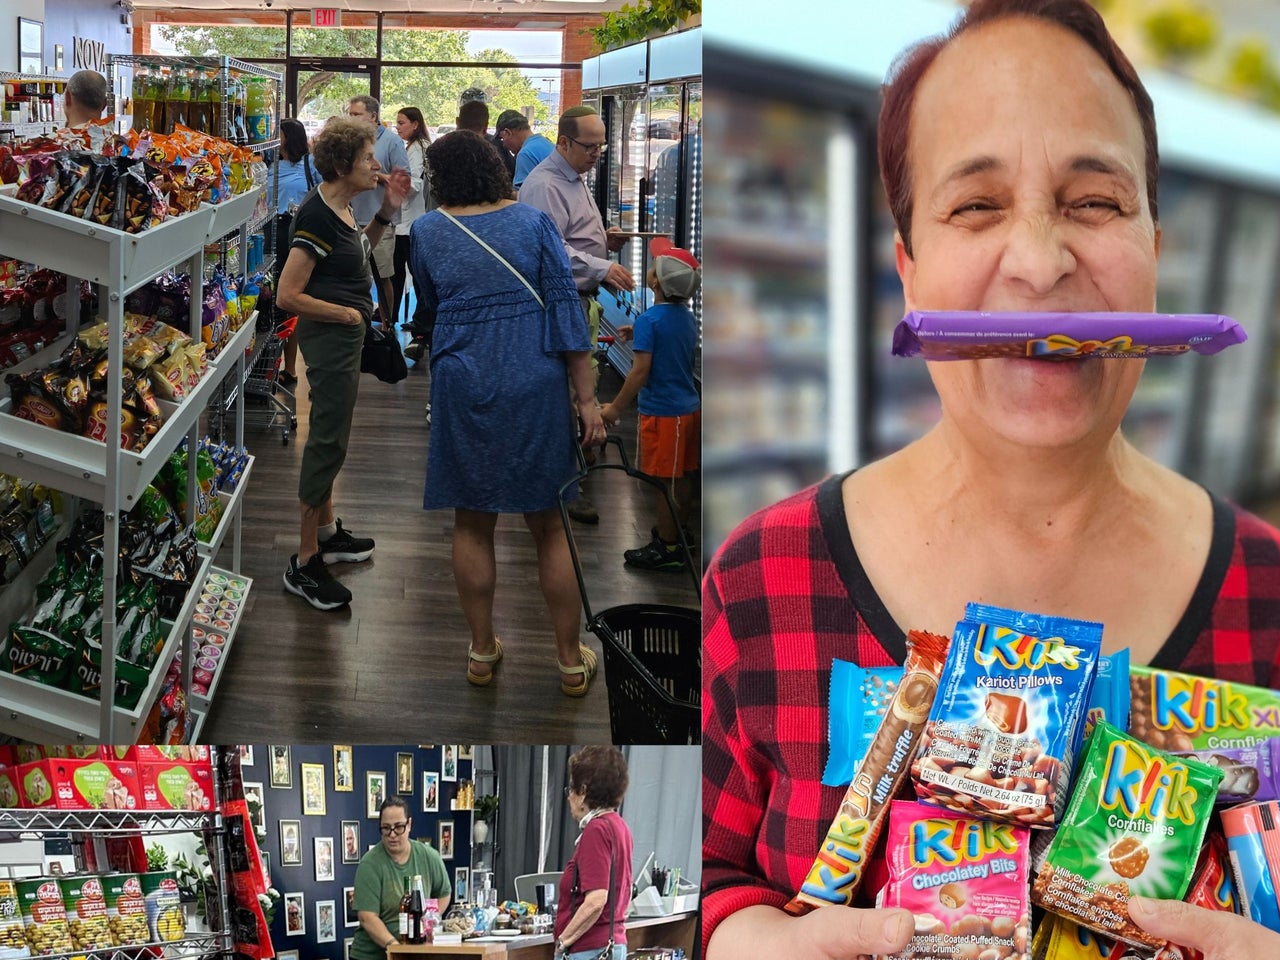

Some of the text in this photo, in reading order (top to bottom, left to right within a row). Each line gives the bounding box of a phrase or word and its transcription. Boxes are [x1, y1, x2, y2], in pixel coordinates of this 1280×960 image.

[315, 8, 337, 26] EXIT
[73, 36, 106, 72] NOVA
[981, 624, 1079, 669] Klik
[976, 676, 1063, 689] Kariot Pillows
[1155, 671, 1247, 730] Klik
[872, 728, 914, 805] Milk truffle
[1104, 743, 1195, 822] Klik
[958, 779, 979, 792] Poids
[980, 785, 994, 796] Net
[994, 789, 1011, 800] 2.64
[914, 820, 1013, 865] Klik
[800, 820, 867, 906] Klik
[912, 859, 1018, 891] Chocolatey Bits
[1052, 874, 1094, 899] Cornflakes
[1055, 865, 1129, 903] Milk Chocolate Coa
[1043, 894, 1116, 930] de chocolat au lait
[1047, 885, 1125, 923] Cornflakes enrobés
[906, 944, 960, 954] Cookie Crumbs
[911, 934, 1015, 947] hocolate Coated Puffed Snack
